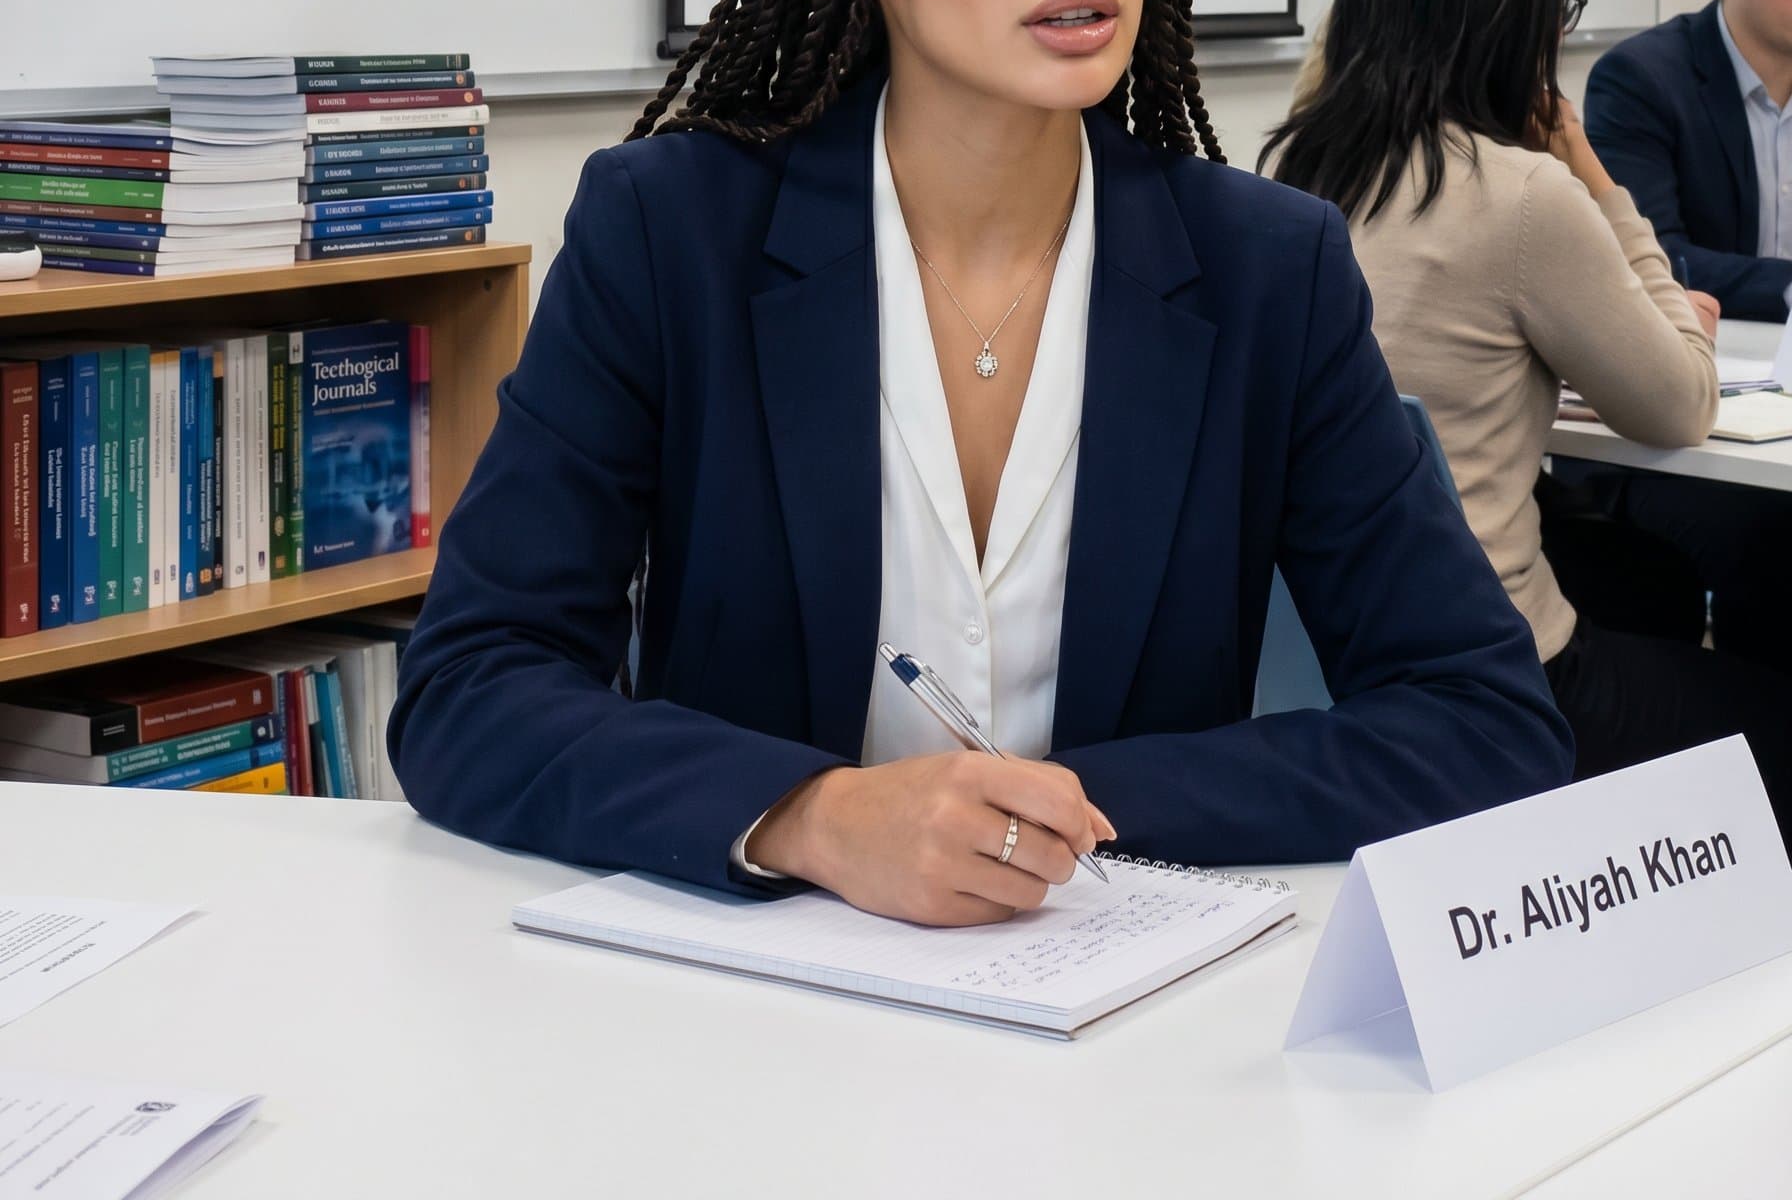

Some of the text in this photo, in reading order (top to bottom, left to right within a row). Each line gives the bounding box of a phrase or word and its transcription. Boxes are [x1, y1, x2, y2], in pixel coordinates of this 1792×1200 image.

[311, 374, 377, 407] Journals
[1447, 831, 1737, 960] Dr. Aliyah Khan
